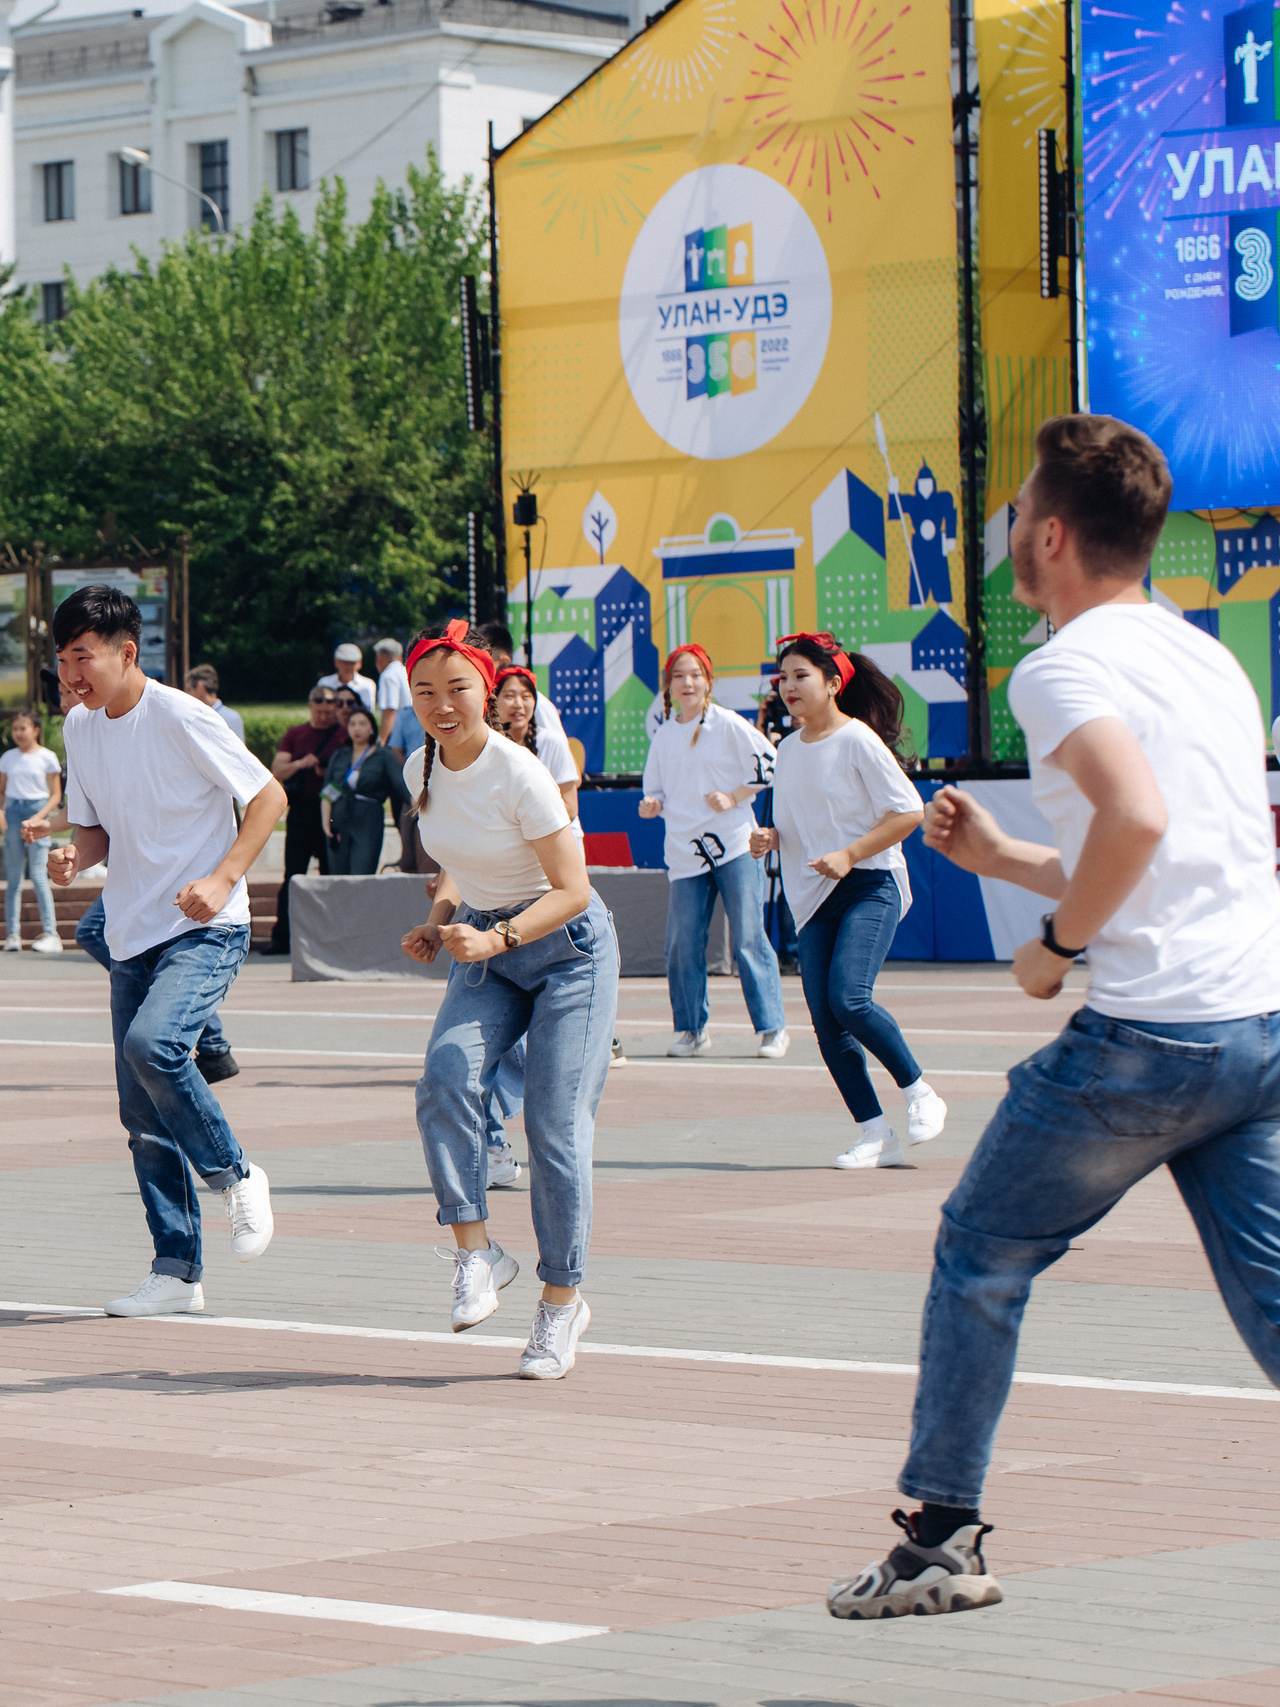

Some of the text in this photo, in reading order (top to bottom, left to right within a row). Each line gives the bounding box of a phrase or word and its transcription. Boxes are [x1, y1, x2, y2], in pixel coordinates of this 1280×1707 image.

[1174, 234, 1221, 263] 1666
[1235, 227, 1273, 301] 3
[658, 292, 788, 330] УЛАН-УДЭ
[760, 337, 789, 353] 2022
